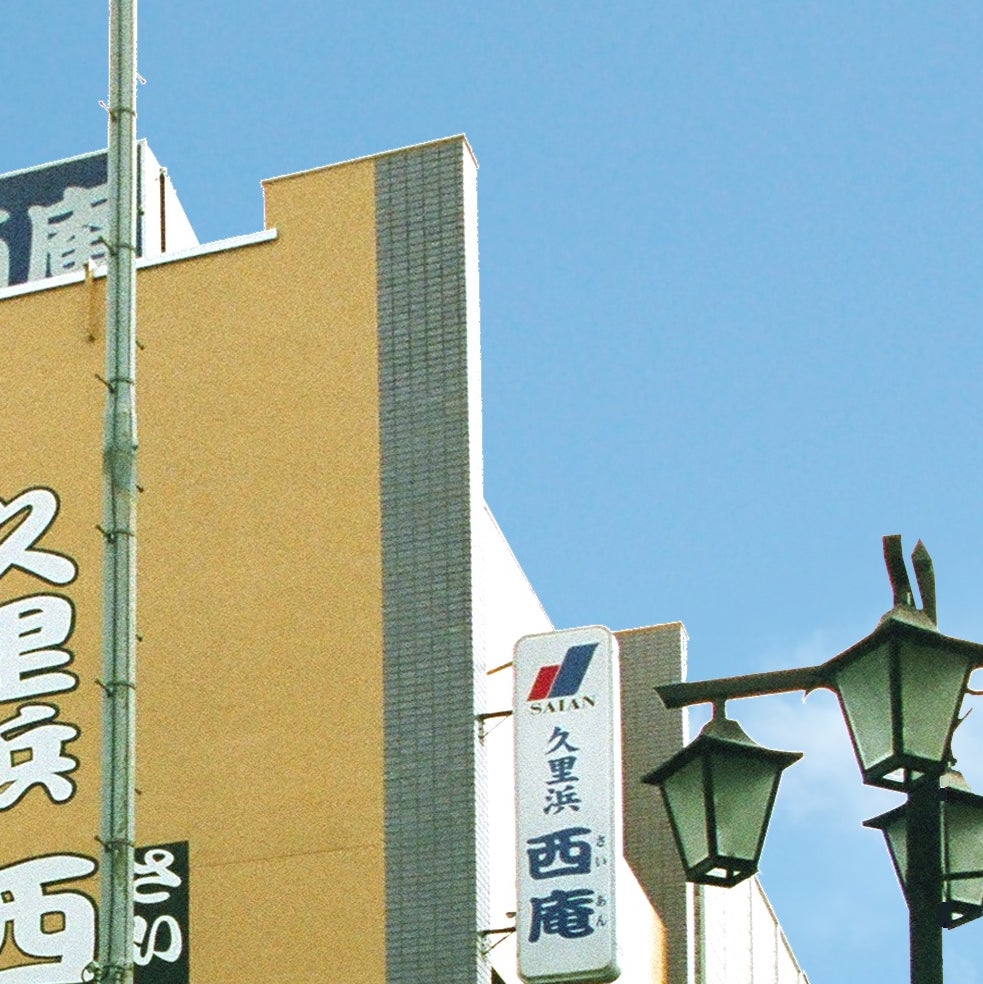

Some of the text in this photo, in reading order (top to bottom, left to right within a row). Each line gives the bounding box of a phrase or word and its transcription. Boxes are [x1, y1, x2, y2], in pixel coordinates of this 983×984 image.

[529, 695, 598, 716] SAIAN
[526, 725, 596, 944] 久里浜 西庵
